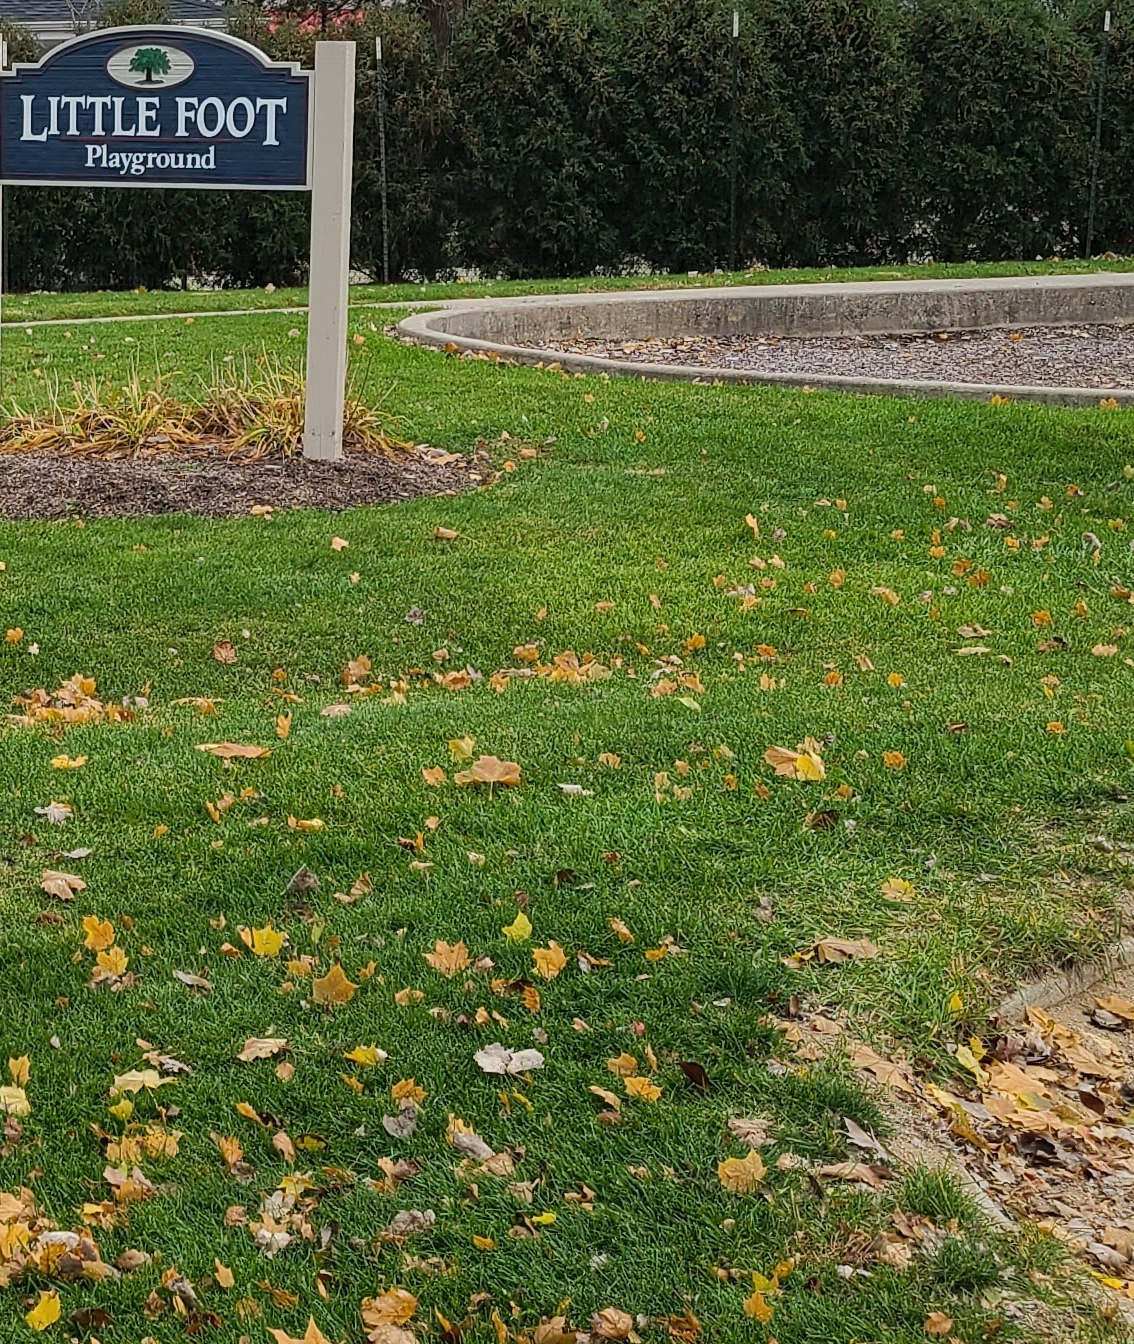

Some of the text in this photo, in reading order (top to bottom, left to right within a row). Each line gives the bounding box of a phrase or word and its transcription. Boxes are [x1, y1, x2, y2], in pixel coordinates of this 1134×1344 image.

[19, 94, 287, 146] LITTLE FOOT
[85, 144, 217, 175] Playground
